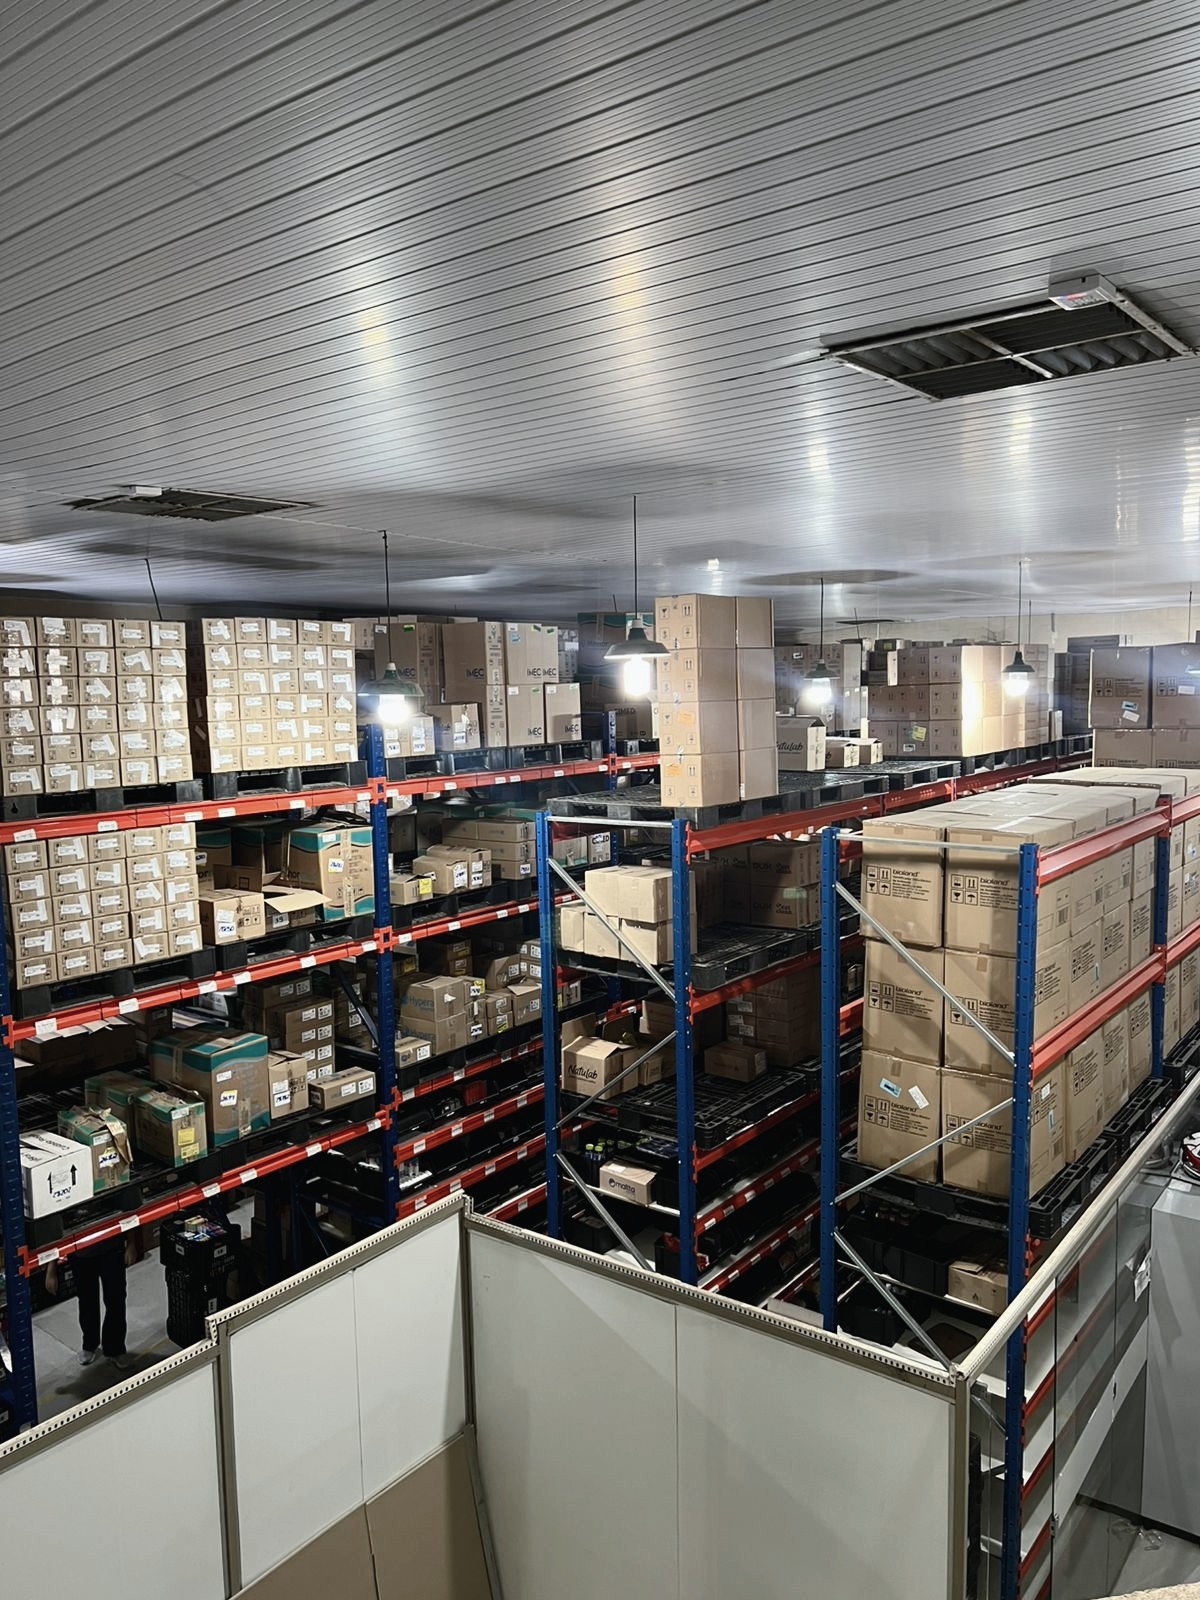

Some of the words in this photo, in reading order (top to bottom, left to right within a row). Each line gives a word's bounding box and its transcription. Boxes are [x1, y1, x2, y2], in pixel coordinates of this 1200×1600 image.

[527, 667, 542, 676] IMEC
[543, 667, 557, 676] IMEC
[528, 727, 542, 736] IMEC
[565, 724, 579, 733] IMEC
[776, 741, 803, 751] atulab
[892, 869, 920, 877] bioland
[980, 877, 1010, 886] bioland
[895, 986, 923, 996] bioland
[980, 1000, 1009, 1009] bioland
[568, 1065, 598, 1079] Natulab
[891, 1102, 917, 1113] bioland
